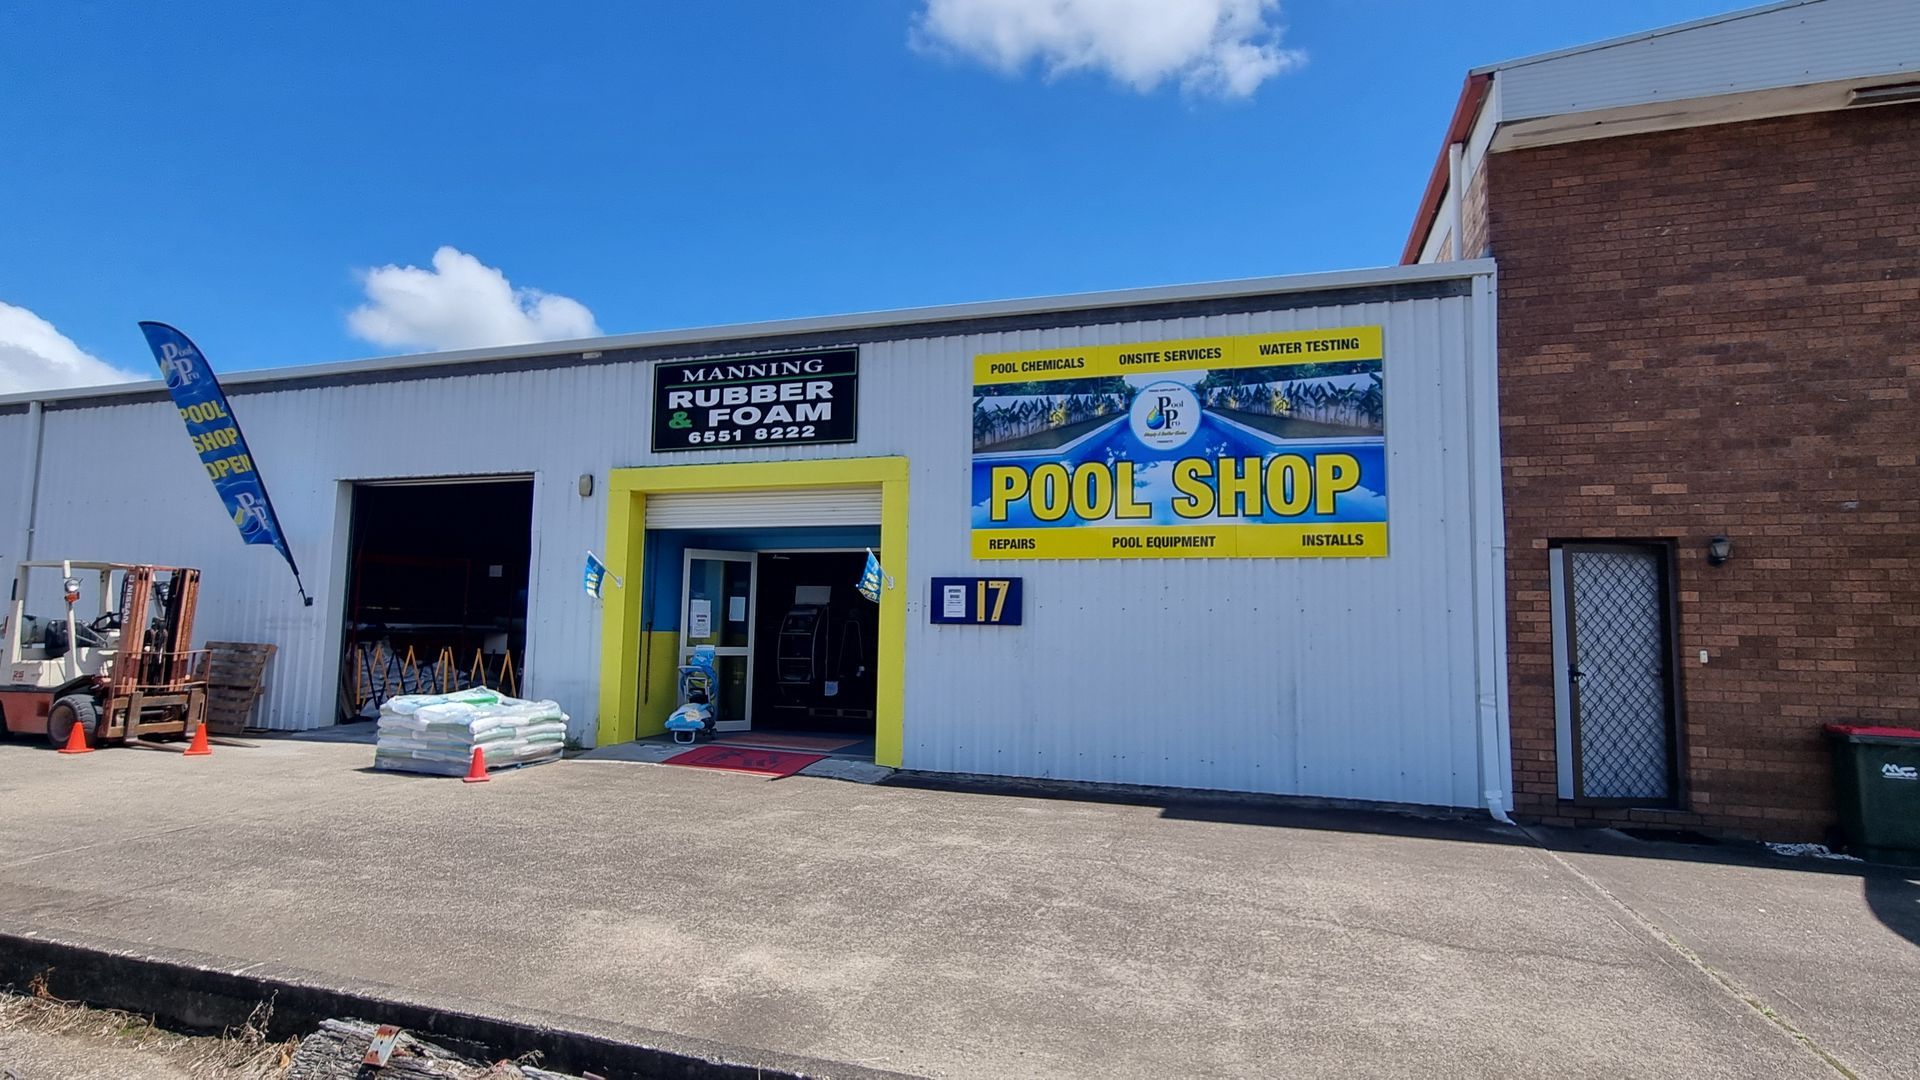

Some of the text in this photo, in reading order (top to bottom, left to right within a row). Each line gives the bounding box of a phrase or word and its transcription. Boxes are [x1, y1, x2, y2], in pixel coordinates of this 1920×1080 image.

[1119, 347, 1222, 366] ONSITE SERVICES
[1259, 338, 1360, 356] WATER TESTING
[682, 359, 824, 383] MANNING
[990, 357, 1085, 375] POOL CHEMICALS
[668, 380, 833, 410] RUBBER
[180, 399, 228, 424] POOL
[668, 402, 832, 429] & FOAM
[1157, 396, 1184, 417] Pool
[1164, 409, 1181, 430] Pro
[191, 427, 239, 454] SHOP
[688, 425, 816, 444] 6551 8222
[203, 453, 253, 480] OPEN
[990, 452, 1361, 522] POOL SHOP
[988, 538, 1036, 550] REPAIRS
[1112, 535, 1217, 549] POOL EQUIPMENT
[1302, 533, 1364, 547] INSTALLS
[122, 585, 134, 624] NISSAN
[977, 580, 1010, 622] 17
